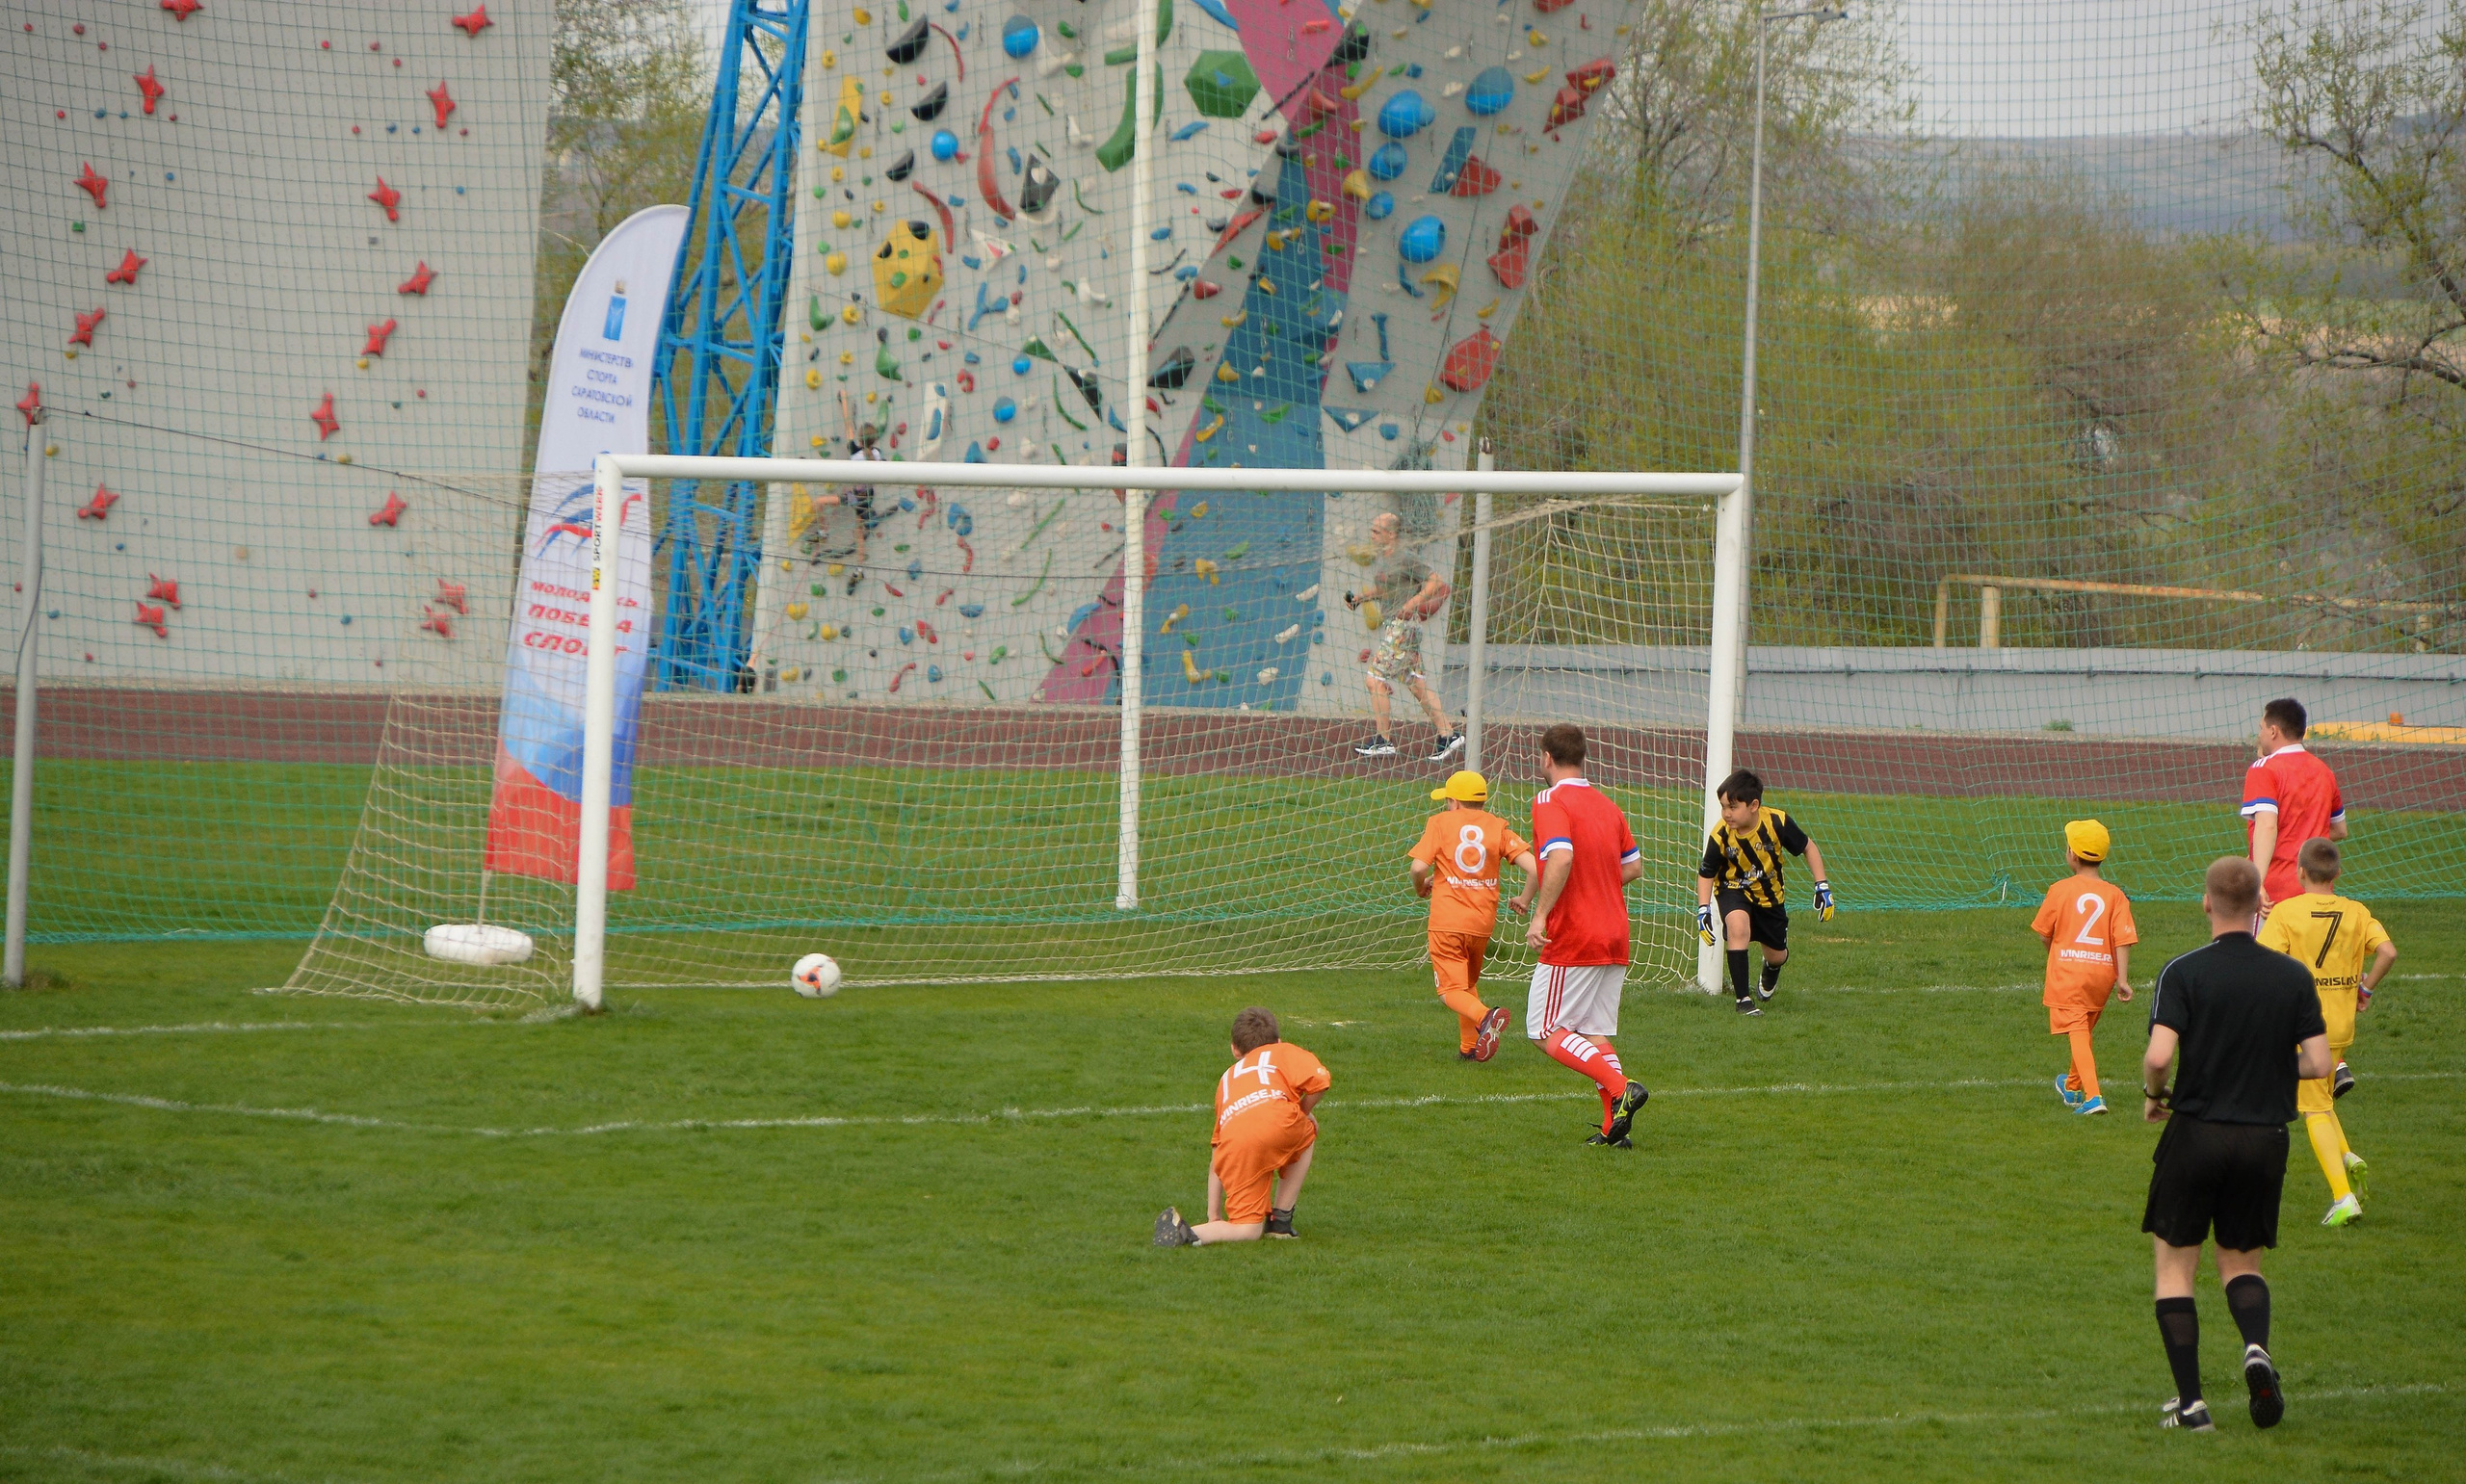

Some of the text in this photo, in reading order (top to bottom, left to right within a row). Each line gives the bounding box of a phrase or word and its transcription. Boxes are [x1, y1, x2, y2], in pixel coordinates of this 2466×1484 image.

[528, 604, 632, 634] ПОБЕА
[523, 631, 628, 657] СПОТ
[1455, 824, 1486, 873] 8
[2076, 893, 2105, 946] 2
[2311, 911, 2344, 969] 7
[2060, 949, 2112, 962] WINRISE.R
[1222, 1051, 1277, 1104] 14
